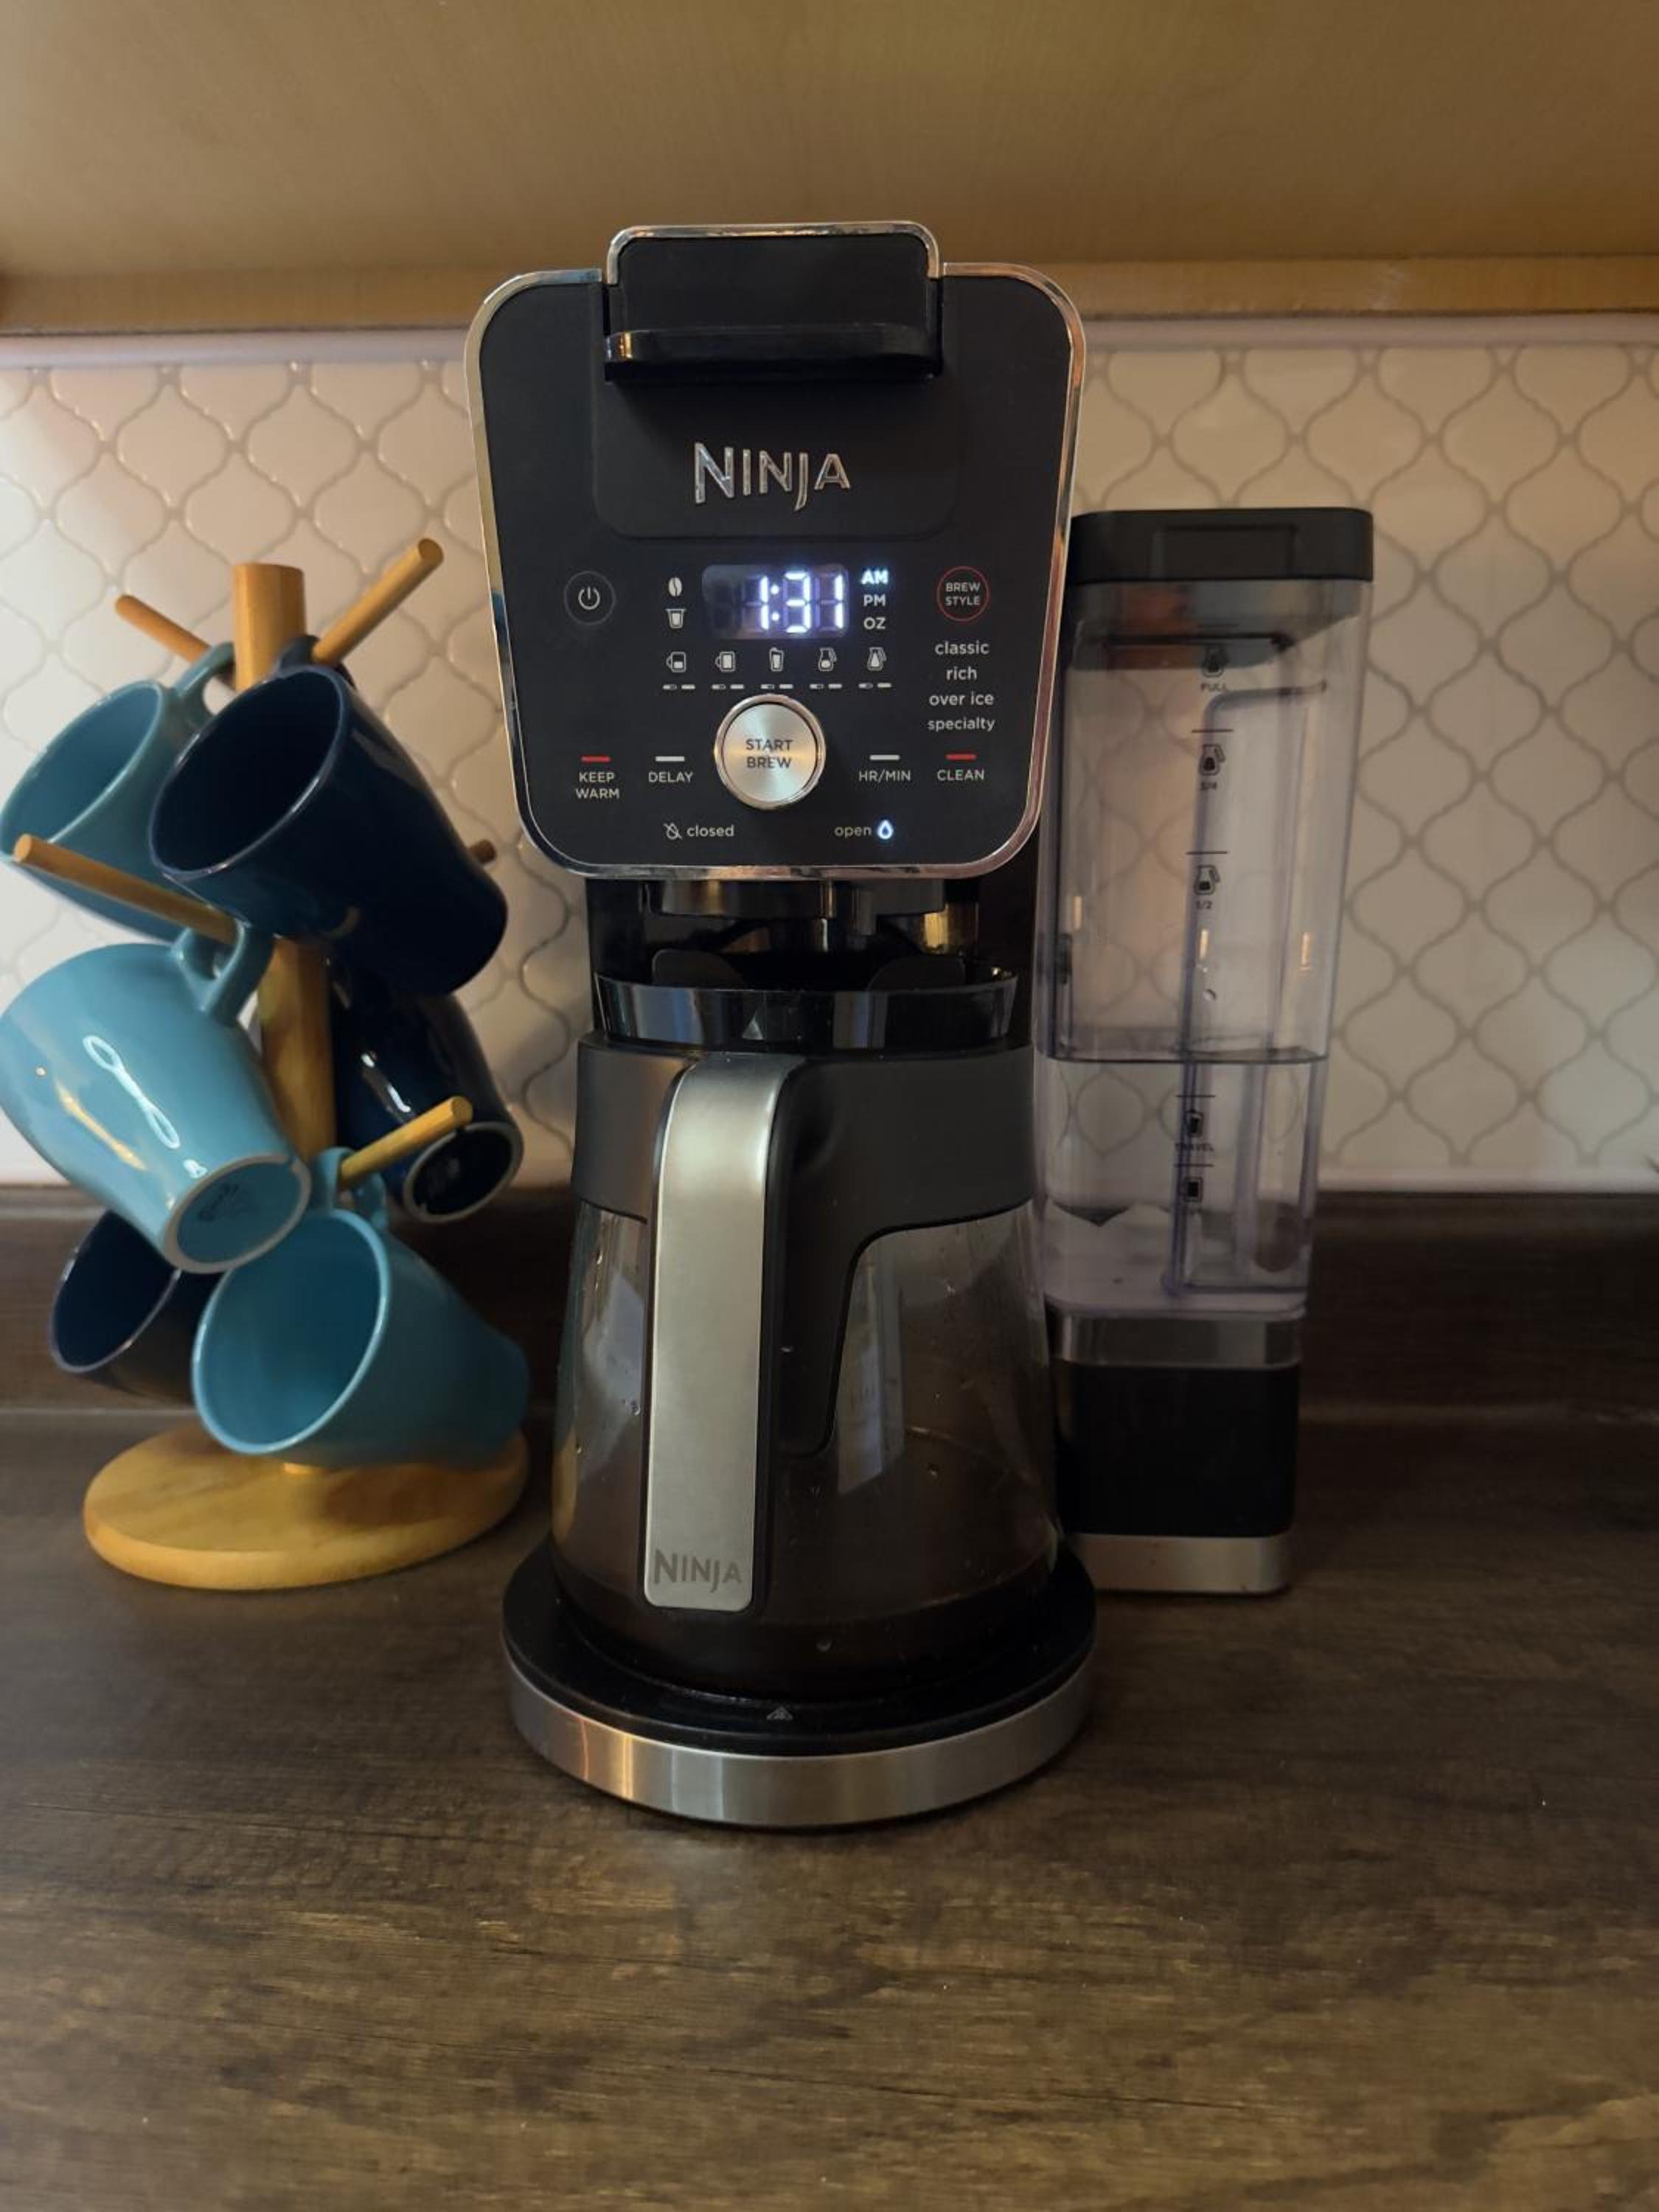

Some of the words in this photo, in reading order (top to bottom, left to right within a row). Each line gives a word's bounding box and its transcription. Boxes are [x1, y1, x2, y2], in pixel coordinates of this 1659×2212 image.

[695, 442, 851, 510] NINJA
[860, 569, 889, 585] AM
[945, 582, 981, 592] BREW
[759, 571, 845, 633] 1:31
[863, 594, 886, 607] PM
[945, 596, 981, 606] STYLE
[863, 617, 886, 630] OZ
[934, 639, 990, 655] classic
[946, 666, 978, 681] rich
[929, 695, 966, 706] over
[970, 690, 995, 706] ice
[927, 716, 995, 732] specialty
[745, 738, 793, 751] START
[746, 756, 793, 769] BREW
[578, 771, 615, 783] KEEP
[648, 771, 694, 783] DELAY
[858, 770, 911, 783] HR/MIN
[937, 769, 985, 782] CLEAN
[575, 787, 620, 799] WARM
[686, 824, 735, 838] closed
[834, 826, 872, 838] open
[654, 1549, 742, 1593] NINJA
